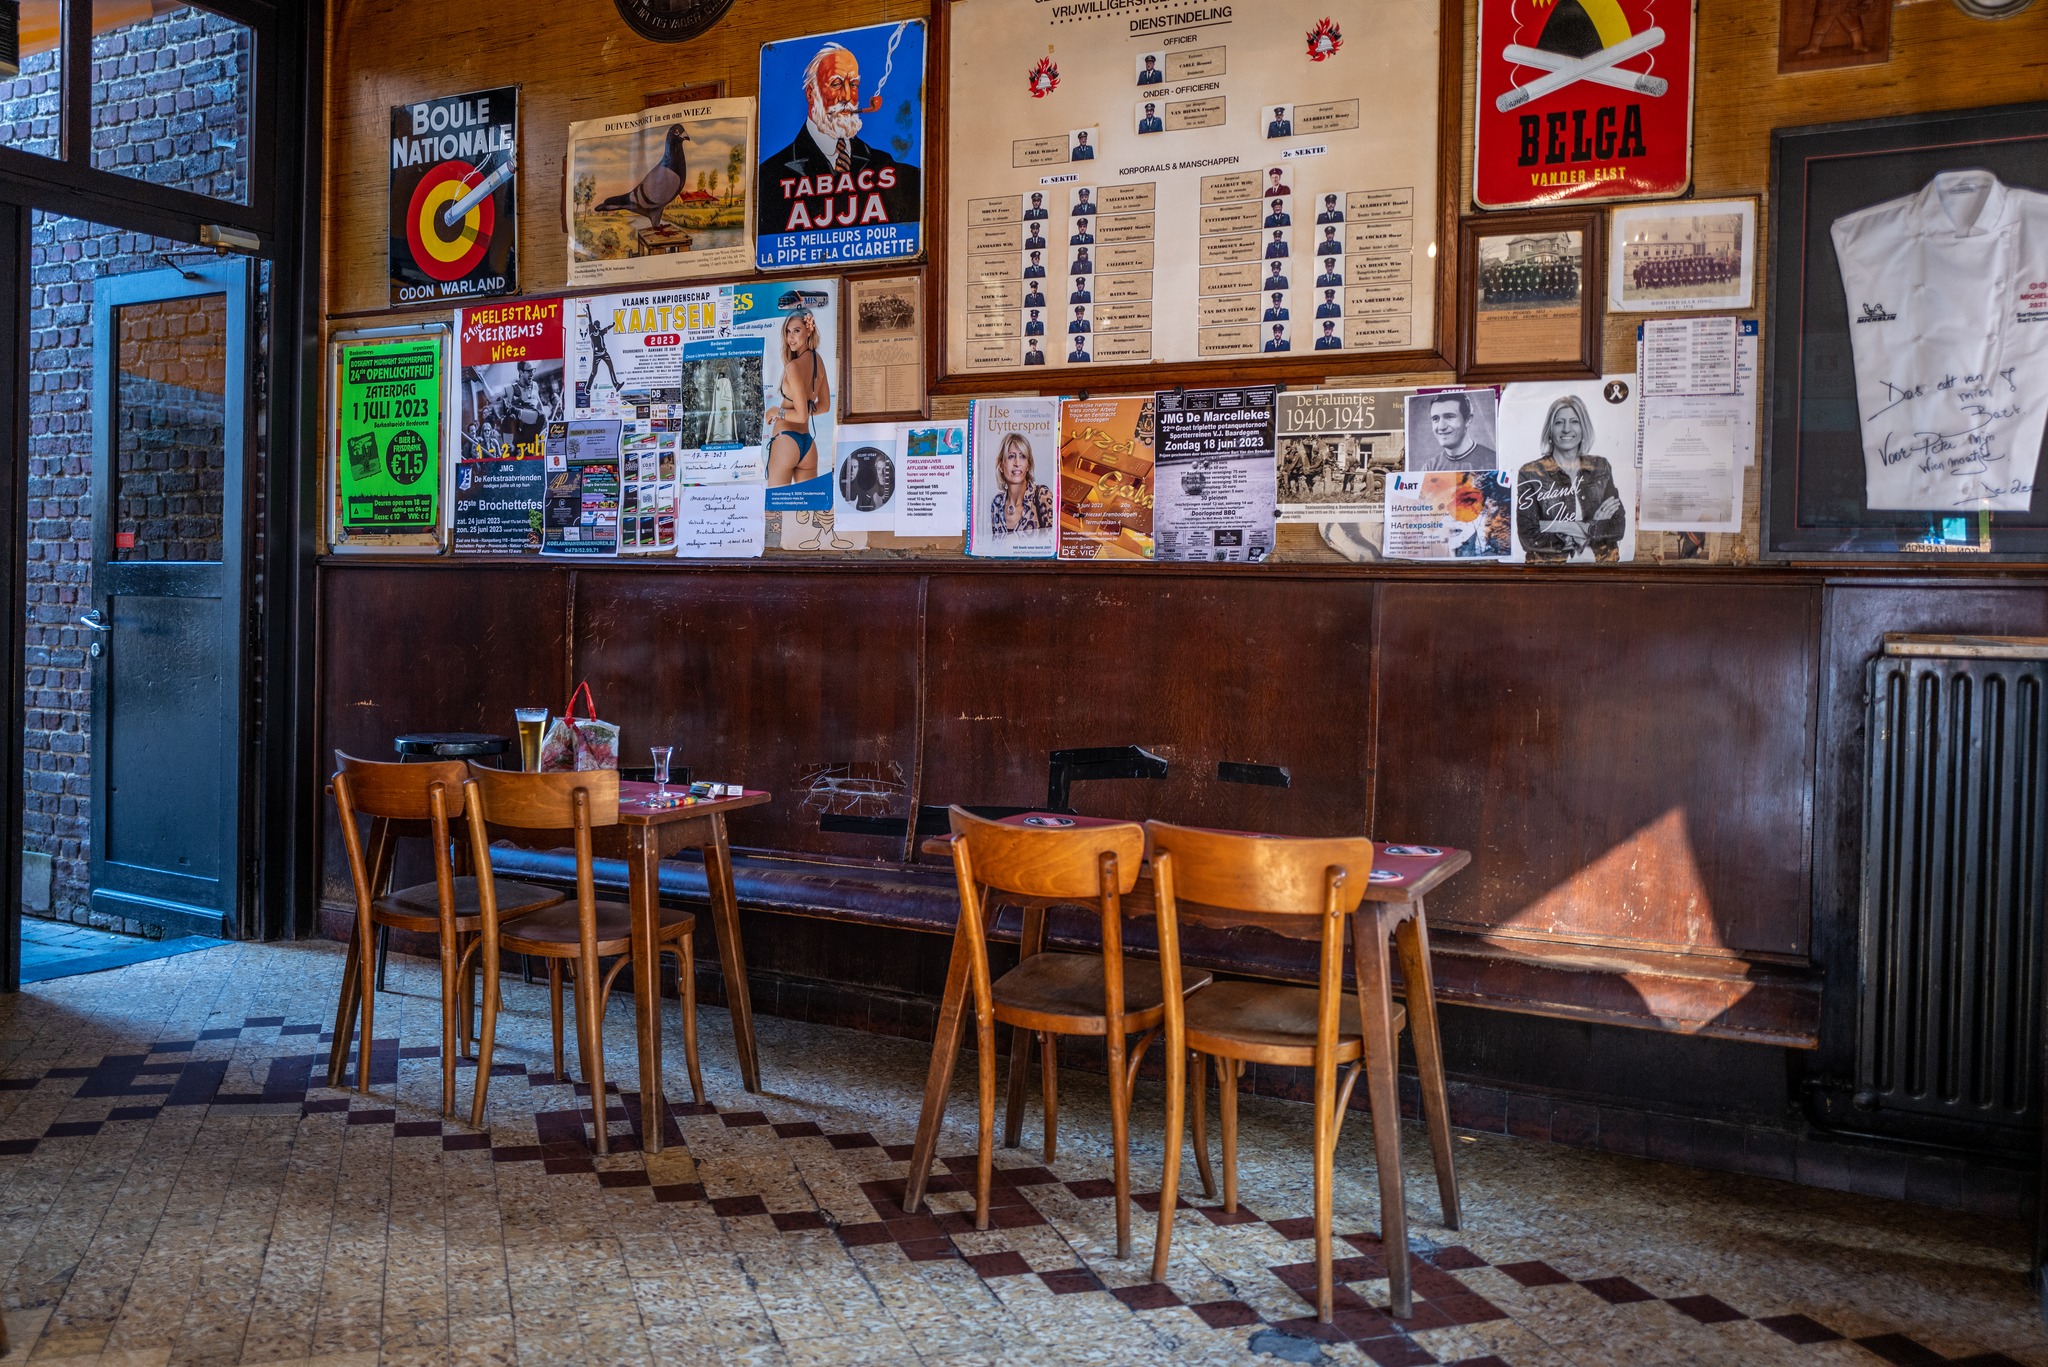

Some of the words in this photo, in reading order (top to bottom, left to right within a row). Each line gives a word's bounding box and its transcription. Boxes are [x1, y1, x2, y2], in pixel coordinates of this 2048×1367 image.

[1130, 6, 1232, 31] DIENSTINDELING
[1163, 35, 1197, 46] OFFICIER
[1143, 88, 1170, 98] ONDER
[1175, 82, 1220, 94] OFFICIEREN
[412, 98, 490, 135] BOULE
[605, 115, 654, 132] DUIVENSPORT
[654, 114, 662, 122] in
[671, 111, 682, 119] om
[683, 107, 712, 117] WIEZE
[1517, 104, 1647, 167] BELGA
[393, 124, 514, 169] NATIONALE
[1294, 146, 1326, 156] SEKTIE
[1119, 163, 1171, 176] KORPORAALS
[1171, 162, 1178, 170] &
[1179, 156, 1240, 169] MANSCHAPPEN
[780, 166, 897, 199] TABACS
[1051, 174, 1079, 183] SEKTIE
[1531, 169, 1586, 186] VANDER
[1594, 166, 1627, 181] ELST
[785, 192, 889, 231] AJJA
[777, 236, 796, 248] LES
[801, 230, 861, 246] MEILLEURS
[866, 227, 897, 241] POUR
[761, 253, 774, 264] LA
[777, 249, 807, 263] PIPE
[811, 249, 822, 260] ET
[825, 248, 839, 259] LA
[842, 238, 914, 257] CIGARETTE
[399, 285, 435, 300] ODON
[440, 276, 506, 295] WARLAND
[622, 297, 649, 306] VLAAMS
[652, 292, 710, 304] KAMPIOENSCHAP
[471, 304, 558, 325] MEELESTRAUT
[613, 302, 716, 334] KAATSEN
[1856, 314, 1897, 324] MICHELIN
[478, 322, 544, 343] KEIRREMIS
[650, 335, 675, 345] 2023
[491, 342, 527, 362] Wieze
[373, 357, 397, 366] MIDNIGHT
[397, 355, 433, 364] SUMMERPARTY
[366, 365, 433, 380] OPENLUCHTFUIF
[365, 383, 417, 399] ZATERDAG
[651, 389, 660, 398] DB
[1296, 395, 1313, 407] De
[1315, 394, 1375, 408] Faluintjes
[353, 403, 359, 420] 1
[363, 401, 390, 424] JULI
[394, 398, 429, 418] 2023
[989, 405, 1010, 418] Ilse
[1160, 412, 1184, 424] JMG
[1186, 411, 1200, 422] De
[1203, 409, 1271, 422] Marcellekes
[988, 419, 1050, 435] Uyttersprot
[1192, 423, 1217, 431] triplette
[1217, 420, 1268, 431] petanquetornooi
[1286, 407, 1375, 432] 1940-1945
[398, 436, 411, 444] BIER
[1169, 431, 1212, 439] Sportterreinen
[1225, 429, 1260, 437] Baardegem
[393, 444, 421, 453] FRISDRANK
[475, 443, 483, 460] 1
[501, 443, 510, 459] 2
[1165, 440, 1201, 452] Zondag
[1203, 439, 1216, 449] 18
[1217, 438, 1237, 451] juni
[1239, 437, 1264, 448] 2023
[391, 453, 424, 475] €1.5
[482, 474, 542, 482] Kerkstraatvrienden
[1516, 475, 1585, 510] Bedankt
[1191, 509, 1223, 517] Doorlopend
[1391, 504, 1434, 512] HArtroutes
[475, 518, 487, 526] juni
[1540, 501, 1577, 534] Ilse
[477, 526, 488, 534] juni
[1390, 522, 1444, 530] HArtexpositie
